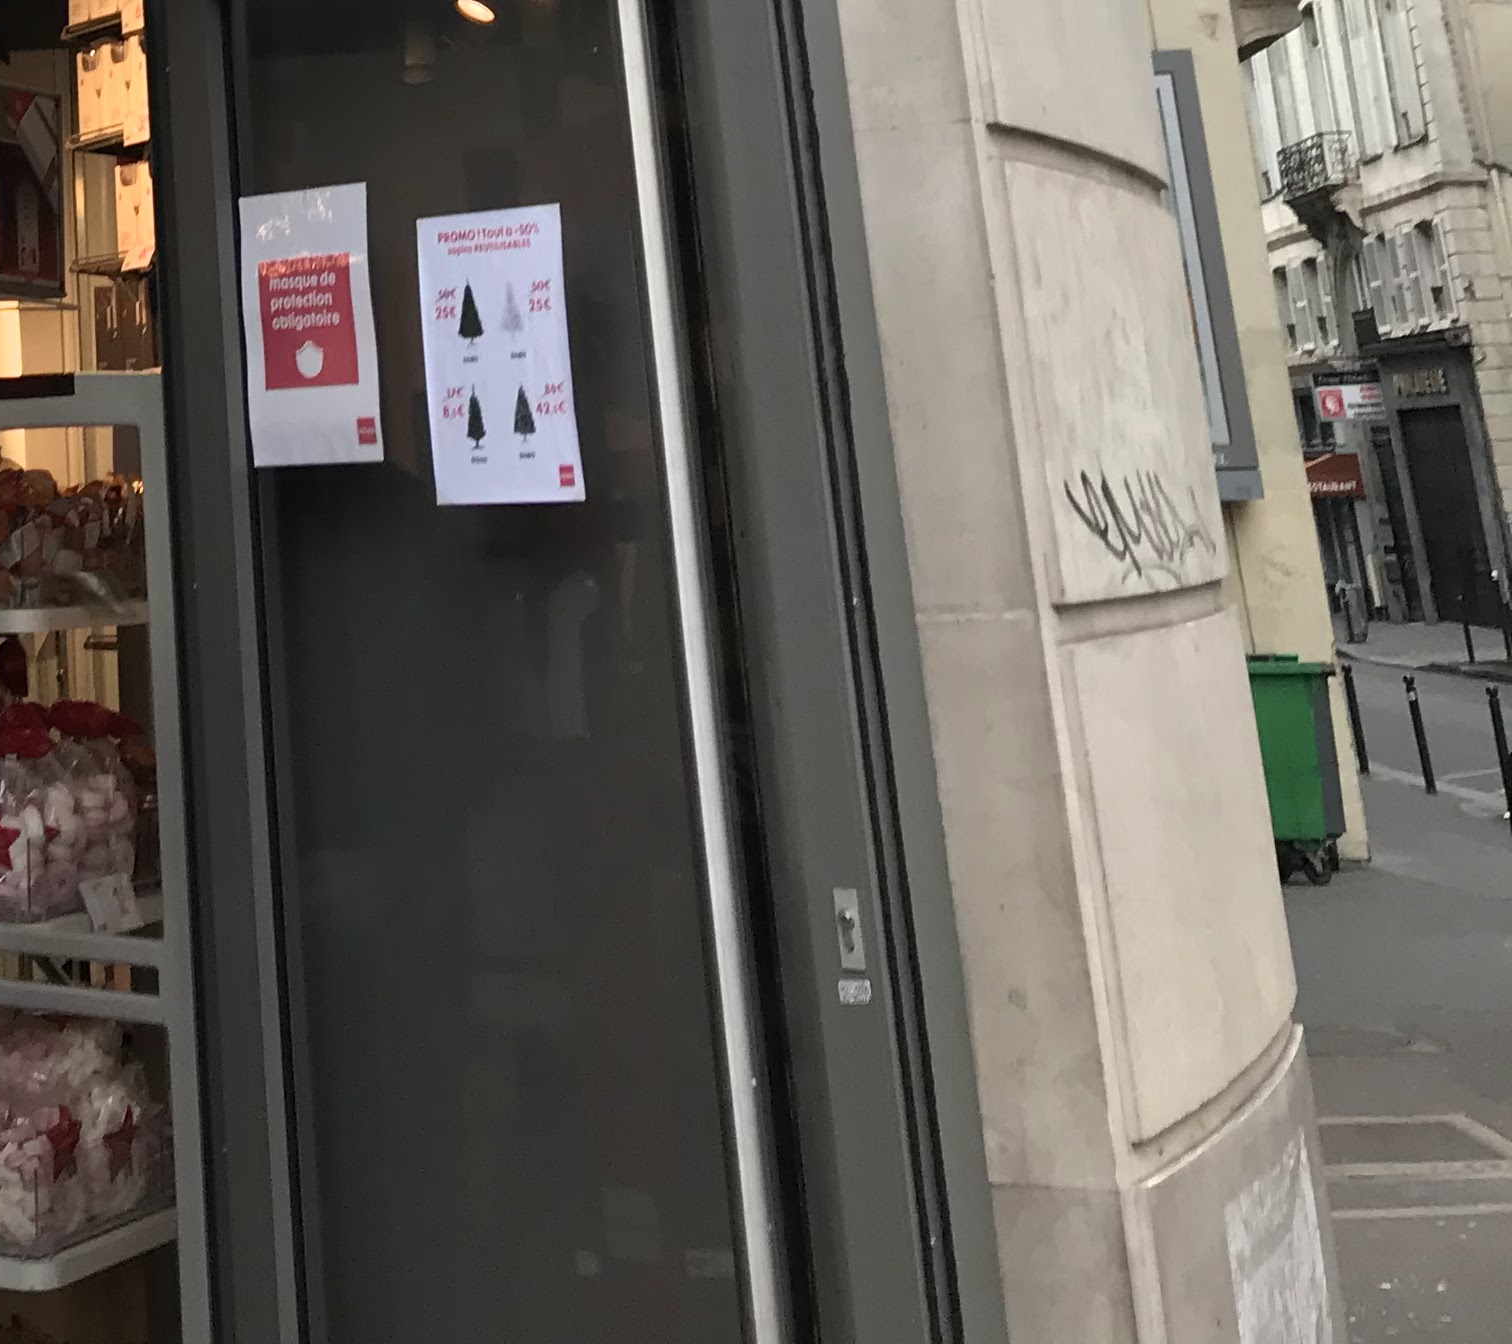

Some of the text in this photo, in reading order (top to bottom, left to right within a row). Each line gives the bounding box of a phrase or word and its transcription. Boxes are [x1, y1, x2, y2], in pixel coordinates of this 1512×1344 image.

[269, 270, 336, 291] masque de
[271, 290, 332, 314] protection
[272, 309, 340, 331] obligatoire
[1308, 480, 1357, 493] STAURANT
